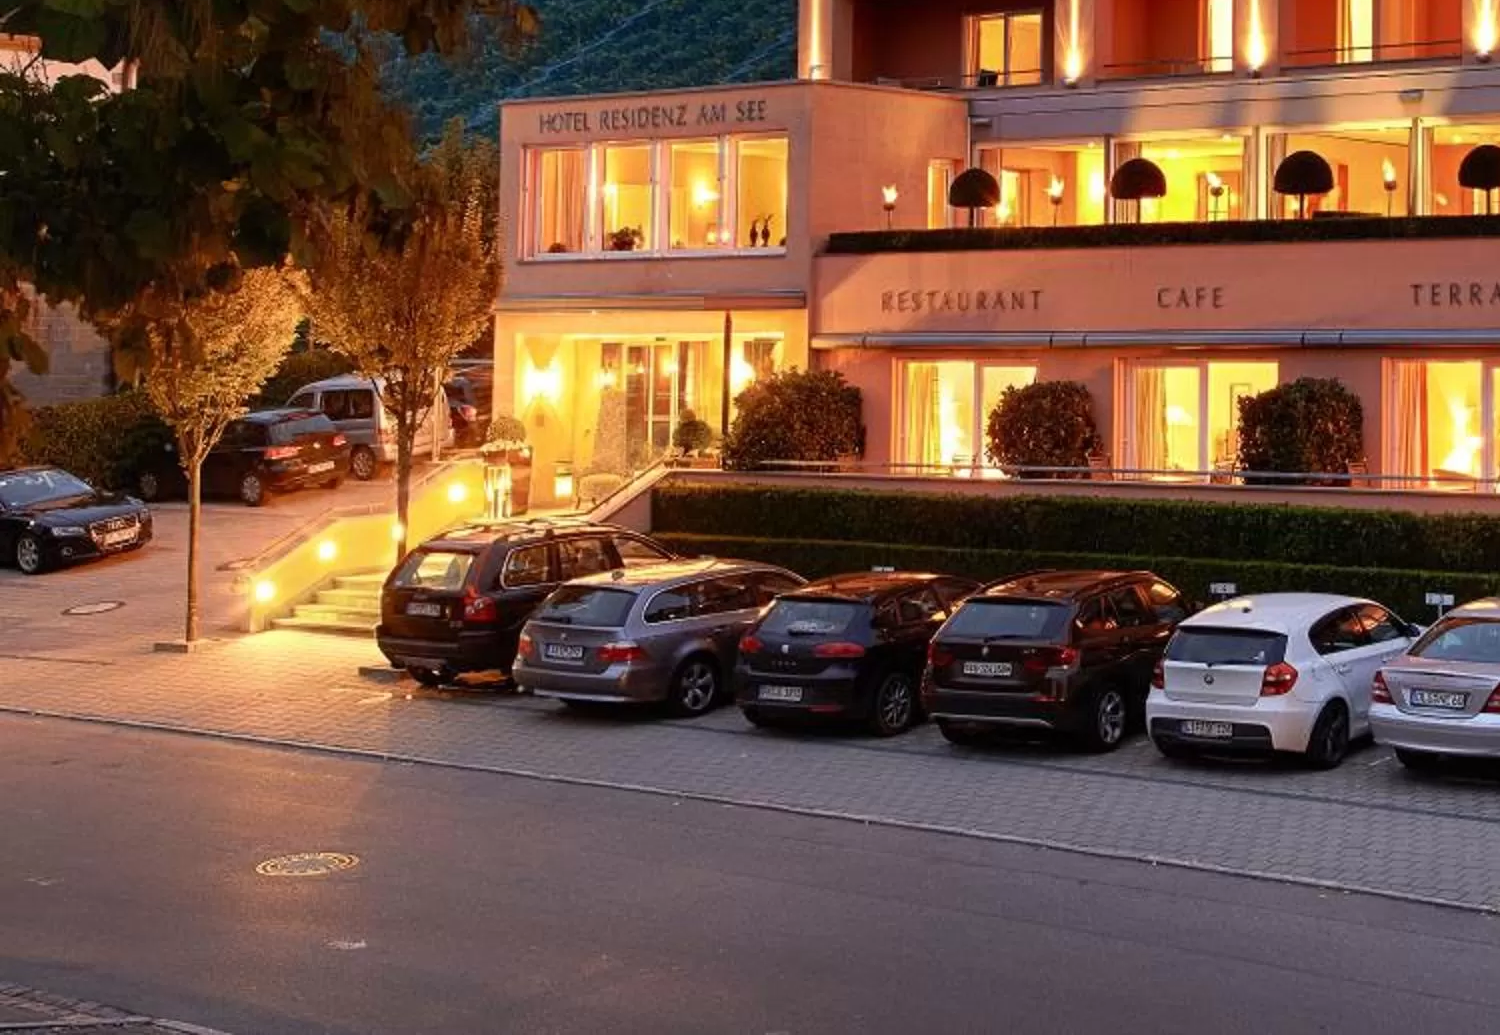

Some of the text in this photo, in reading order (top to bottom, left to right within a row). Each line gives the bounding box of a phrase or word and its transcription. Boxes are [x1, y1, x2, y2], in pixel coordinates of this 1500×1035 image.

[538, 100, 768, 134] HOTEL RESIDENZ AM SEE
[881, 289, 1043, 312] RESTAURANT
[1157, 287, 1224, 310] CAFE
